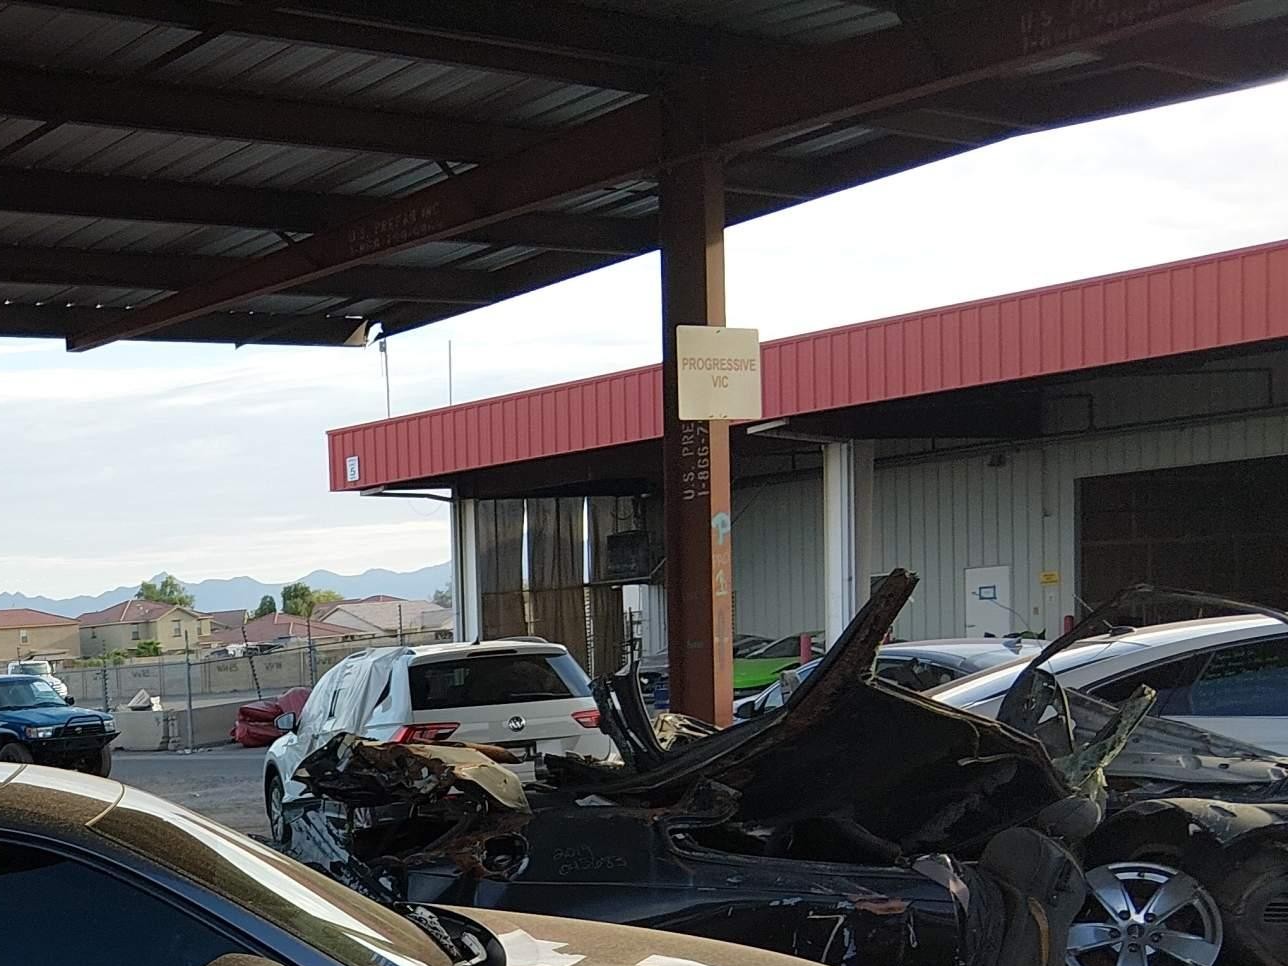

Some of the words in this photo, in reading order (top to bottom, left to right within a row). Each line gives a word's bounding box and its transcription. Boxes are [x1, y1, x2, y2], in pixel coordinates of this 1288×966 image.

[681, 357, 757, 372] PROGRESSIVE
[711, 375, 729, 389] VIC
[696, 420, 710, 496] 1-866-7
[349, 467, 356, 476] 5
